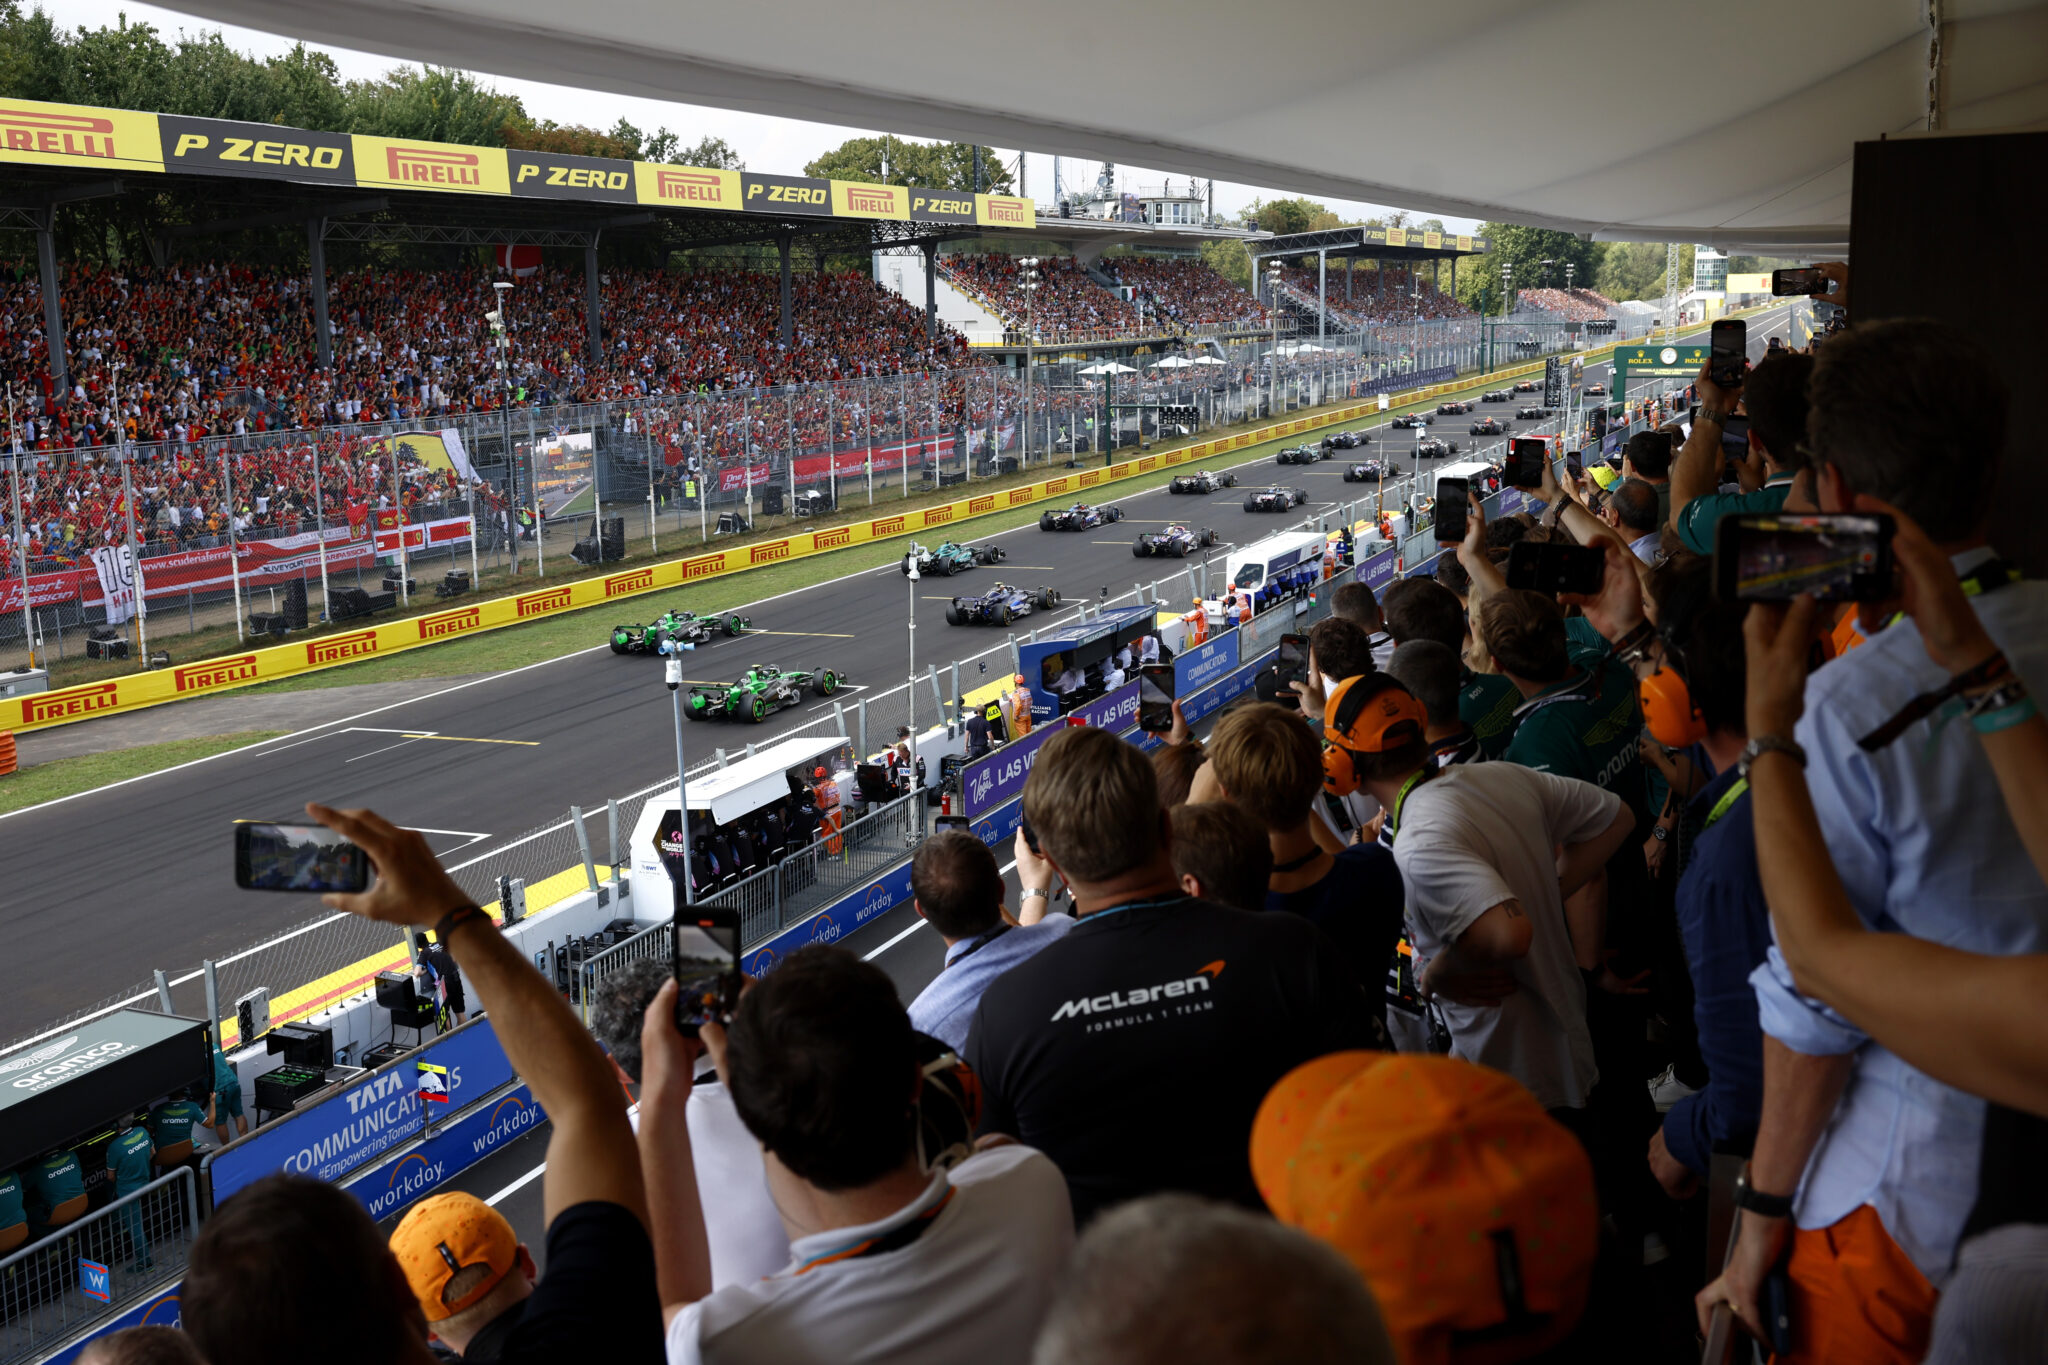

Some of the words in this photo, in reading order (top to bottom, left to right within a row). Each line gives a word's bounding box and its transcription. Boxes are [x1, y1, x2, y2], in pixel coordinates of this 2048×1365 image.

[174, 133, 209, 157] P
[219, 138, 343, 169] ZERO
[387, 147, 480, 186] PIRELLI
[516, 164, 540, 183] P
[546, 166, 629, 190] ZERO
[657, 171, 721, 202] PIRELLI
[747, 184, 764, 200] P
[767, 185, 827, 205] ZERO
[847, 187, 895, 213] PIRELLI
[913, 197, 925, 211] P
[927, 199, 973, 215] ZERO
[987, 200, 1024, 223] PIRELLI
[1079, 471, 1100, 487] PIRELLI
[1110, 464, 1129, 479] PIRELLI
[1009, 487, 1033, 505] PIRELLI
[1046, 478, 1068, 495] PIRELLI
[925, 505, 953, 525] PIRELLI
[969, 495, 995, 514] PIRELLI
[813, 528, 850, 550] PIRELLI
[872, 516, 905, 537] PIRELLI
[750, 541, 789, 564] PIRELLI
[682, 554, 725, 579] PIRELLI
[605, 569, 653, 597] PIRELLI
[516, 588, 572, 617] PIRELLI
[419, 608, 480, 640] PIRELLI
[306, 631, 377, 665] PIRELLI
[174, 655, 258, 692] PIRELLI
[1187, 651, 1228, 681] COMMUNICATIONS
[21, 683, 118, 724] PIRELLI
[1097, 706, 1117, 729] LAS
[1117, 691, 1141, 718] VEGA
[998, 758, 1022, 786] LAS
[1597, 735, 1640, 787] aramc
[1050, 975, 1210, 1022] McLaren
[1086, 1012, 1154, 1033] FORMULA
[1162, 1009, 1168, 1018] 1
[1176, 1001, 1214, 1015] TEAM
[12, 1041, 124, 1088] aramco
[29, 1068, 84, 1092] FORMULA
[82, 1057, 108, 1069] ONE
[107, 1044, 140, 1058] TEAM
[346, 1070, 404, 1115] TATA
[127, 1139, 150, 1155] aramco
[48, 1163, 76, 1179] aramco
[88, 1271, 105, 1289] W
